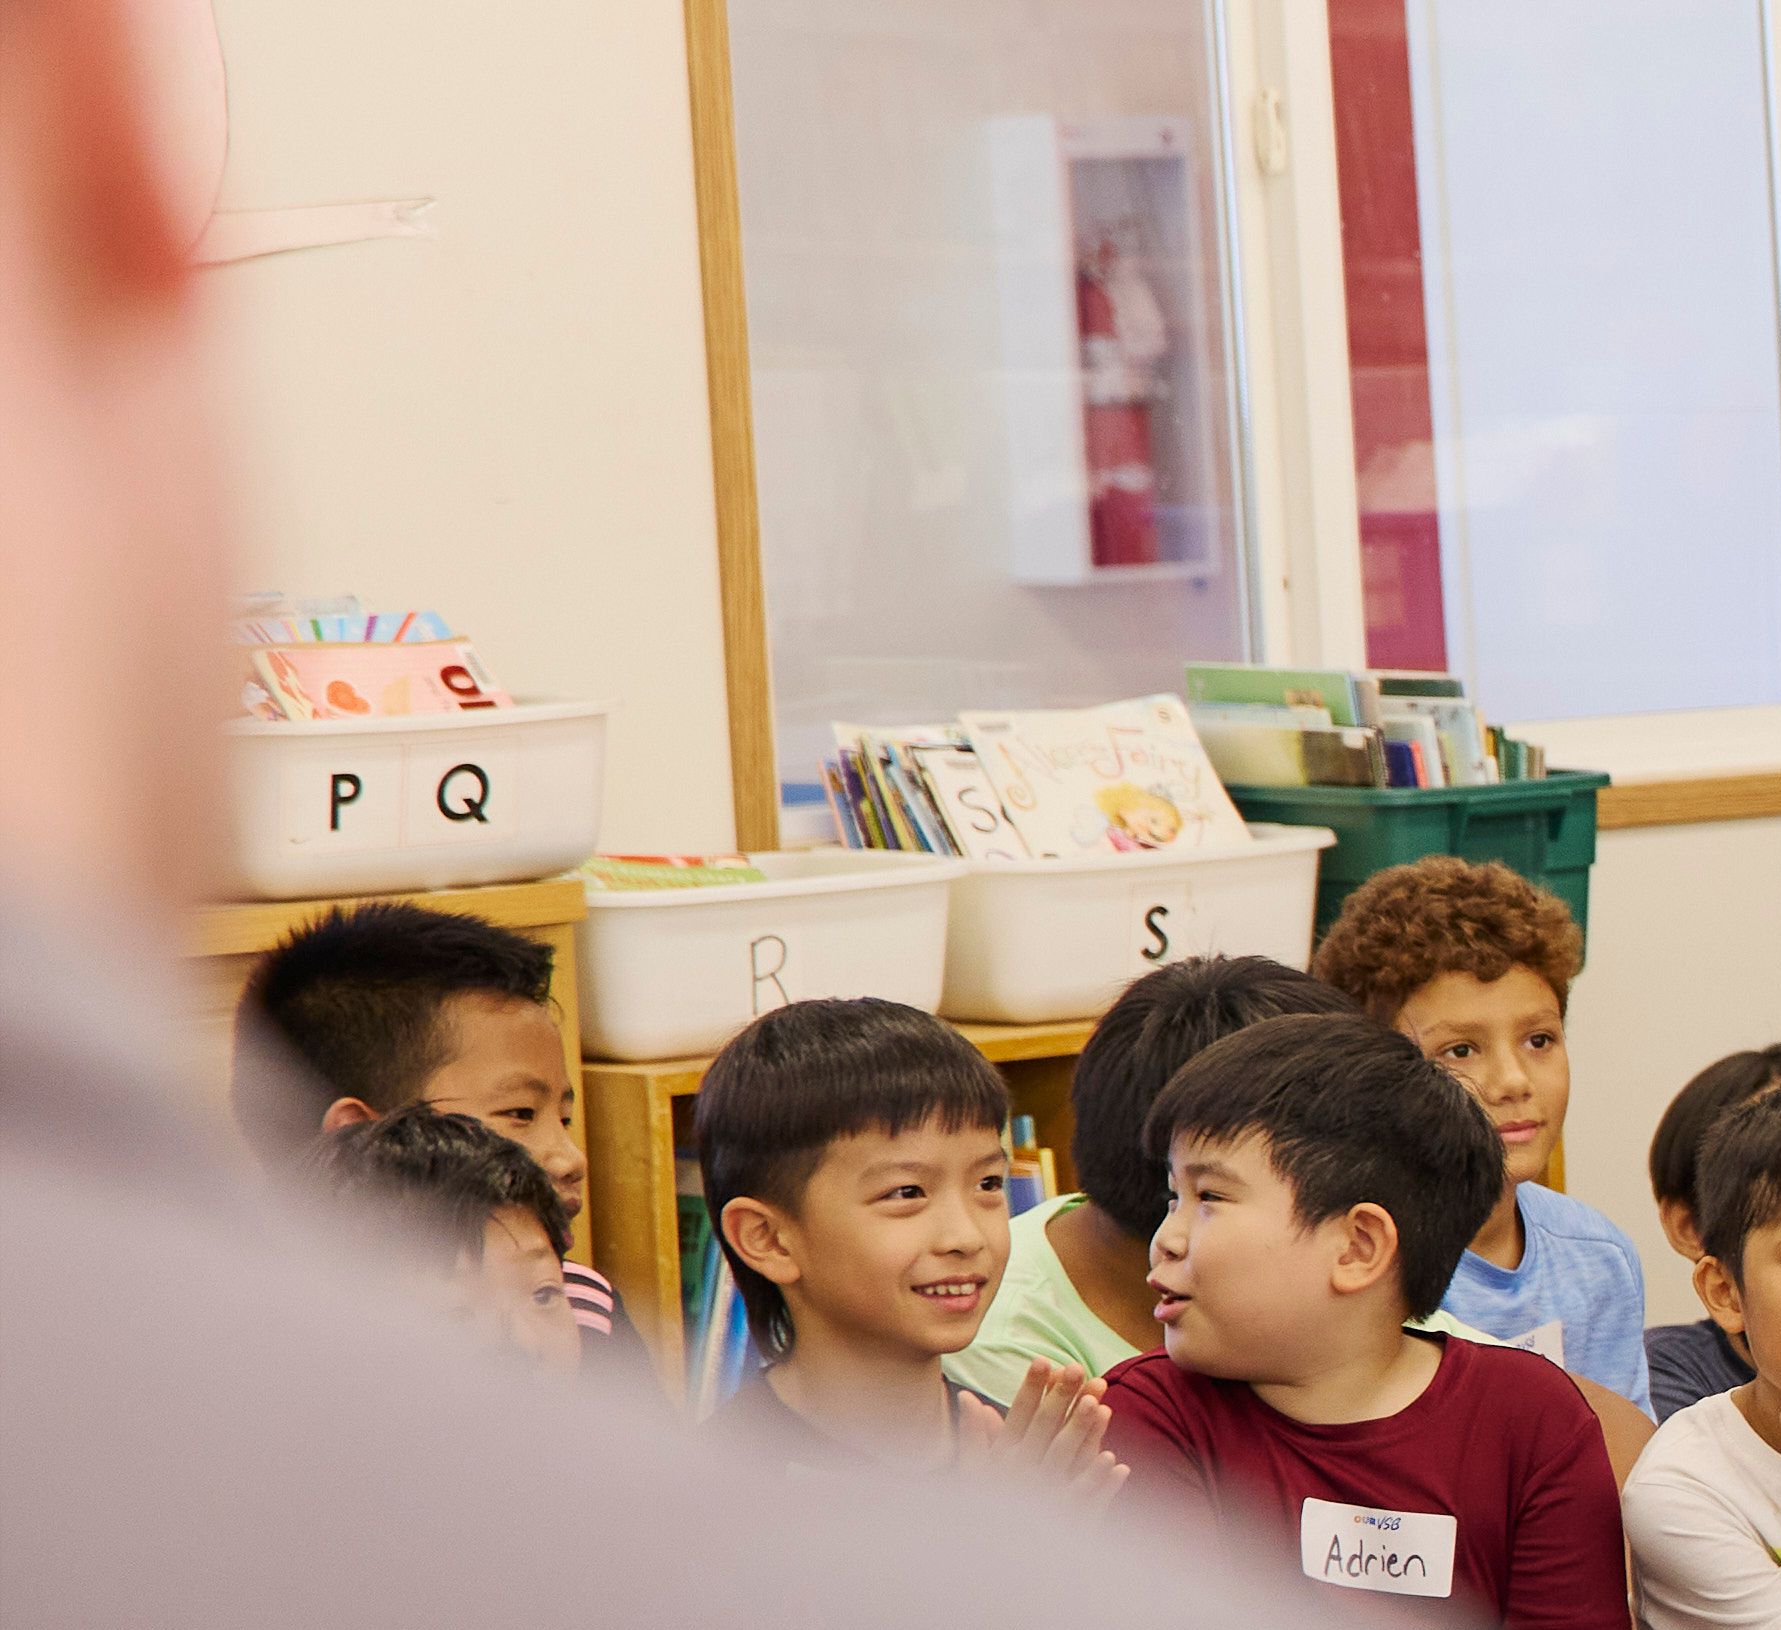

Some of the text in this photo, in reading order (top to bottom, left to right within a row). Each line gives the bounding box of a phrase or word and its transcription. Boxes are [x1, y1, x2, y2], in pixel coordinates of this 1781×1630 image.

[330, 763, 490, 831] P Q
[1141, 905, 1168, 960] S
[750, 935, 789, 1017] R
[1324, 1533, 1426, 1578] Adrien
